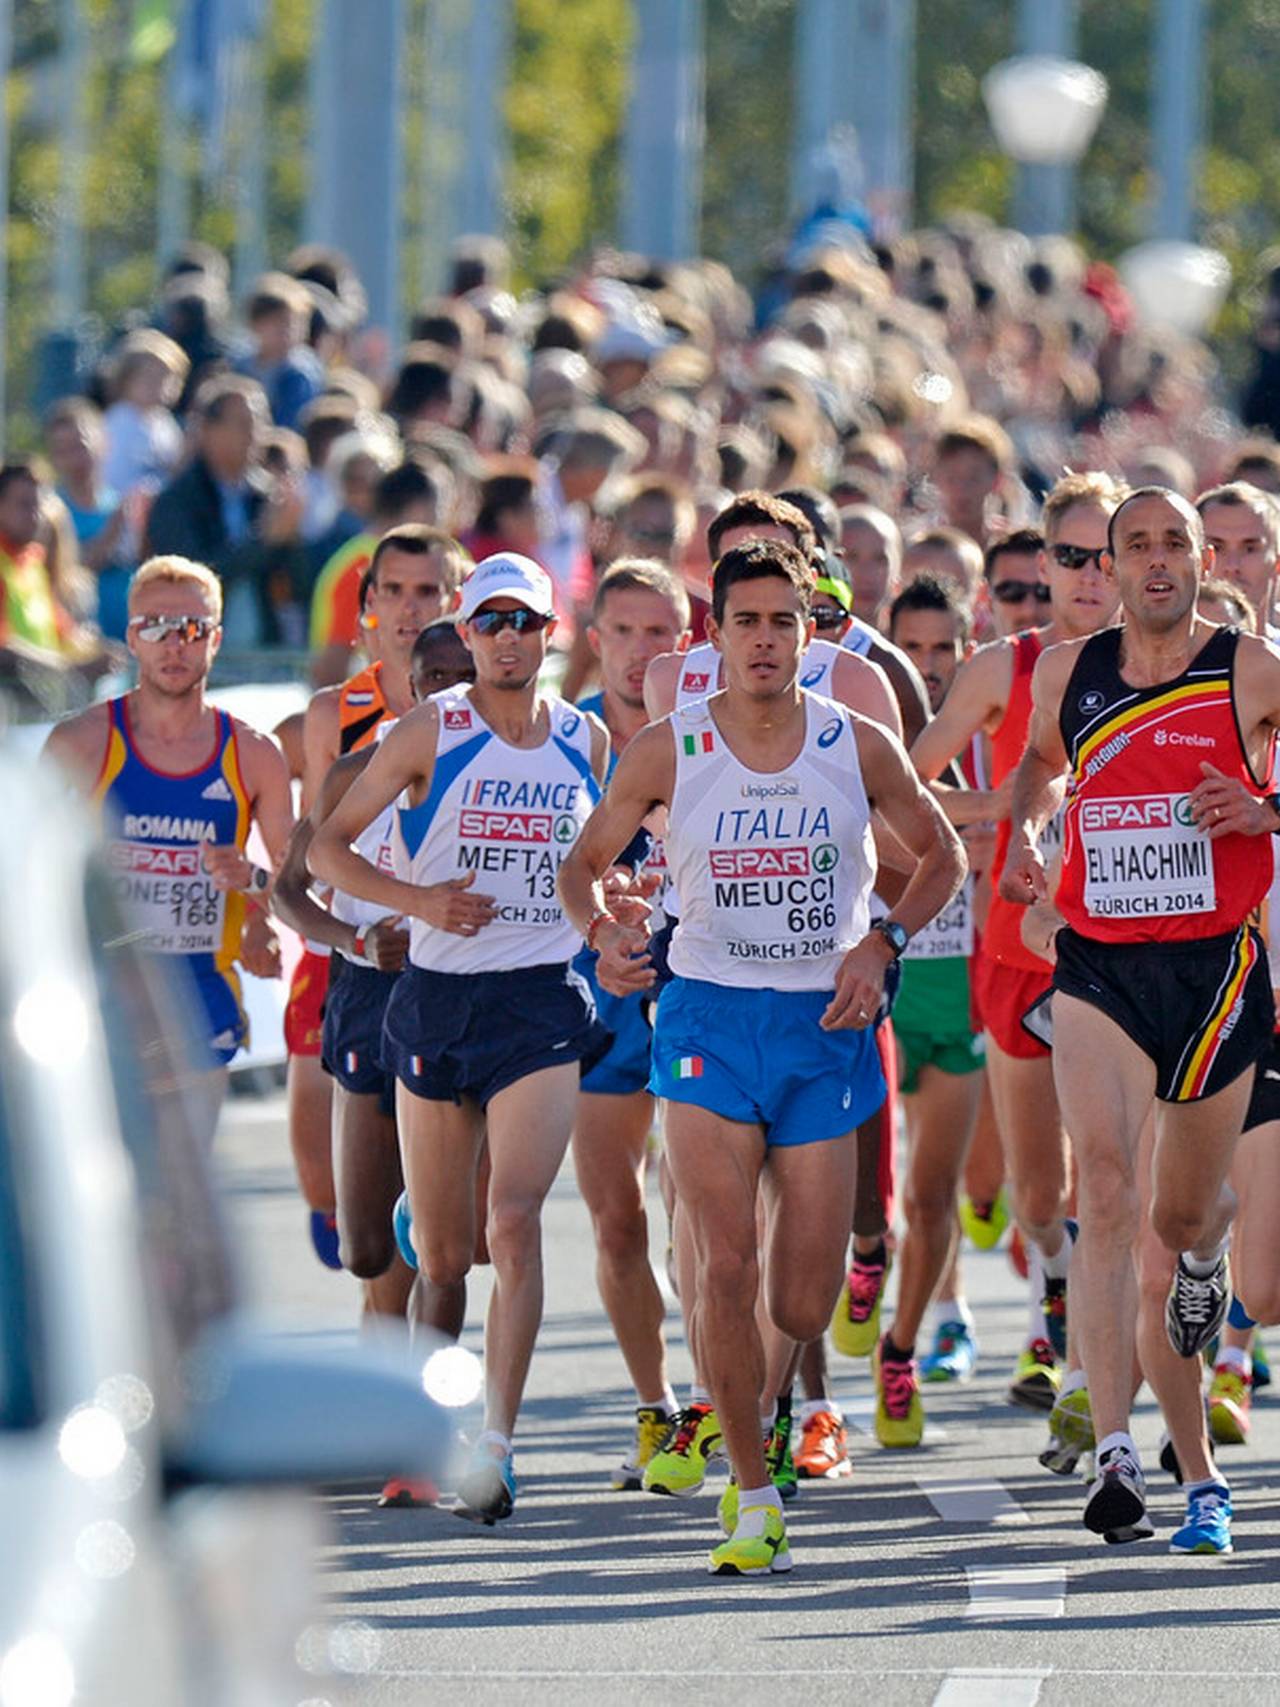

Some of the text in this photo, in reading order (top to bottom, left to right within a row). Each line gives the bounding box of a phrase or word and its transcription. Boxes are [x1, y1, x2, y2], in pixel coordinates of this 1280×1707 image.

[1169, 732, 1216, 747] Crelan
[478, 779, 580, 811] FRANCE
[124, 814, 217, 843] ROMANIA
[460, 812, 550, 842] SPAR
[714, 806, 831, 843] ITALIA
[1083, 800, 1169, 831] SPAR
[111, 848, 198, 875] SPAR
[711, 849, 809, 877] SPAR
[1088, 841, 1207, 884] EL HACHIMI
[113, 876, 220, 904] ONESCU
[525, 874, 556, 899] 13
[715, 875, 835, 908] MEUCCI
[171, 905, 218, 927] 166
[788, 903, 837, 933] 666
[1094, 893, 1205, 915] ZÜRICH 2014
[727, 937, 836, 960] ZÜRICH 2014
